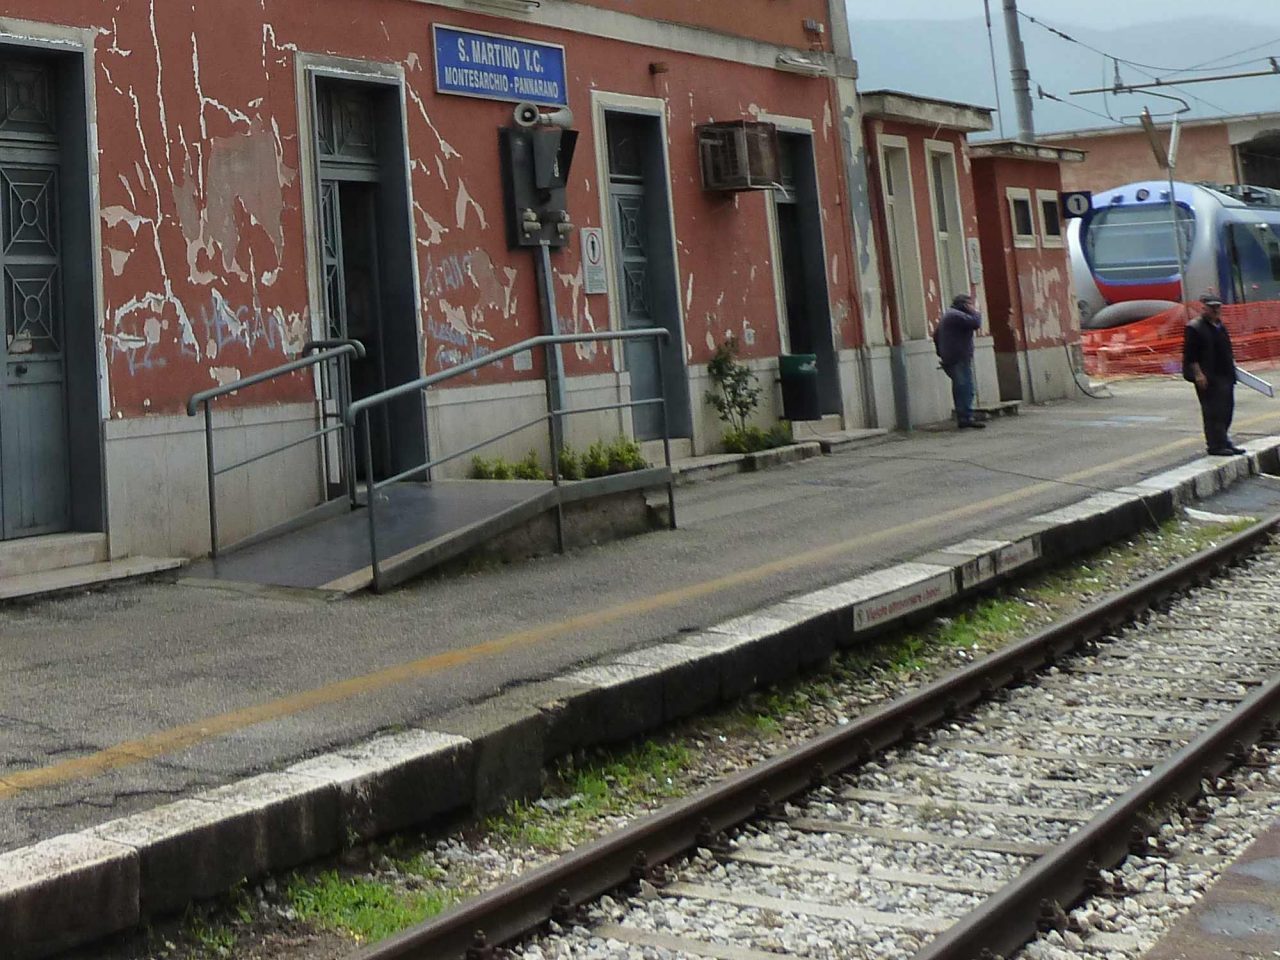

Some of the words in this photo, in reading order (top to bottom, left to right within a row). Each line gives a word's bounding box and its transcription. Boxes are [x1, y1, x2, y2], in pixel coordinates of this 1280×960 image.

[458, 38, 470, 62] S.
[471, 40, 520, 70] MARTINO
[523, 48, 544, 73] V.C.
[444, 66, 509, 92] MONTESARCHIO
[514, 76, 559, 99] PANNARANO
[1073, 197, 1081, 211] 1
